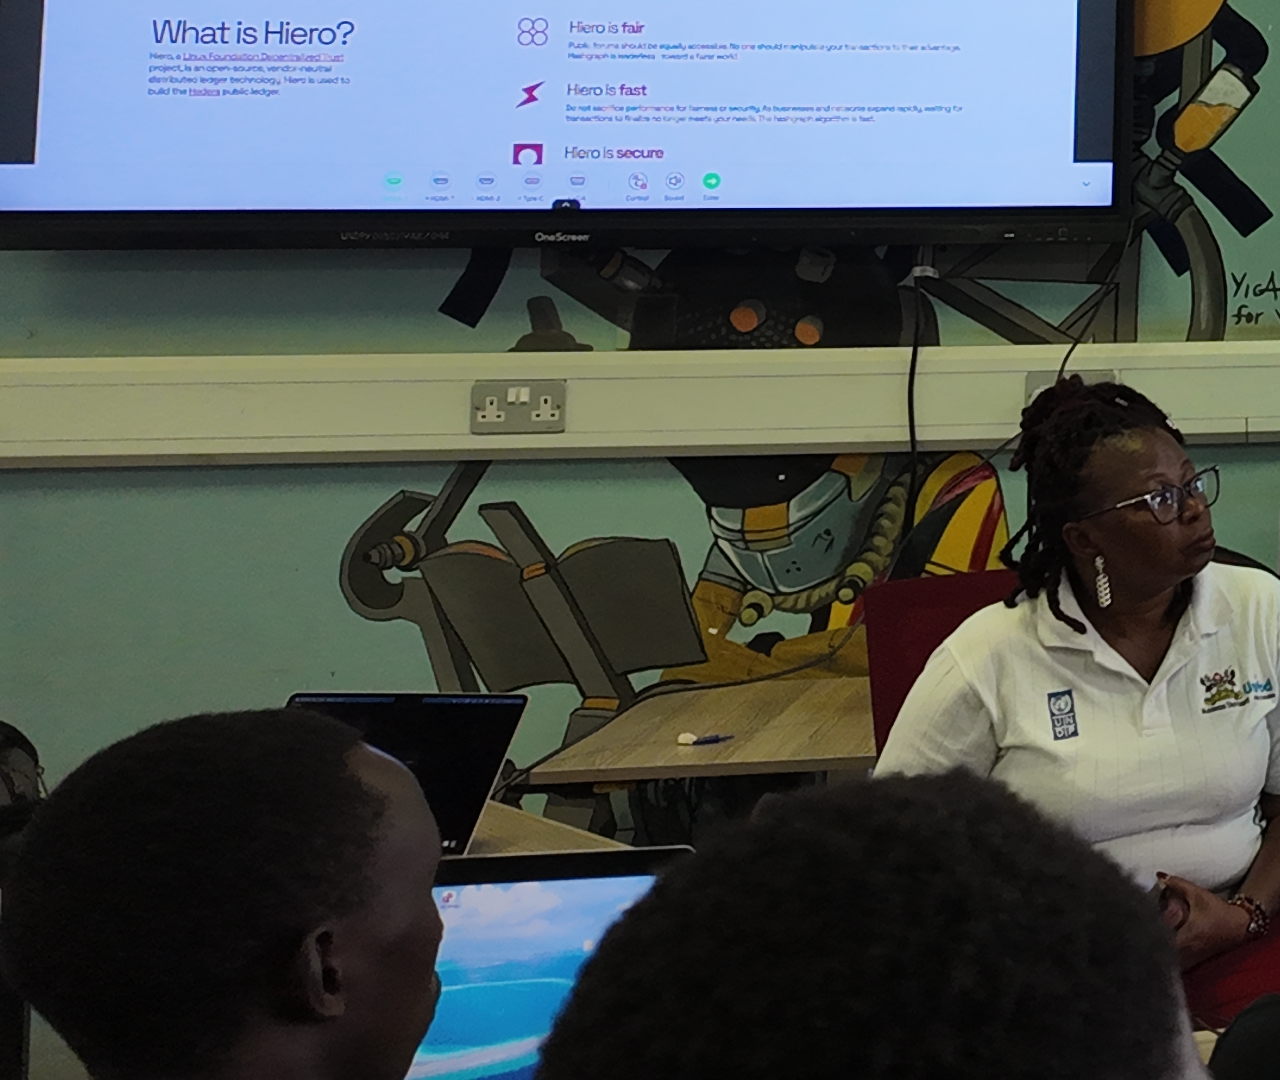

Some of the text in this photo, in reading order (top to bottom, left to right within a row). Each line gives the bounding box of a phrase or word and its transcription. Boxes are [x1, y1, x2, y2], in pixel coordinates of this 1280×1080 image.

[153, 19, 355, 46] What is Hiero?
[569, 21, 645, 34] Hiero is fair
[567, 83, 648, 96] Hiero is fast
[564, 146, 664, 159] Hiero is secure
[534, 231, 591, 244] OneScreen
[1231, 304, 1264, 326] for
